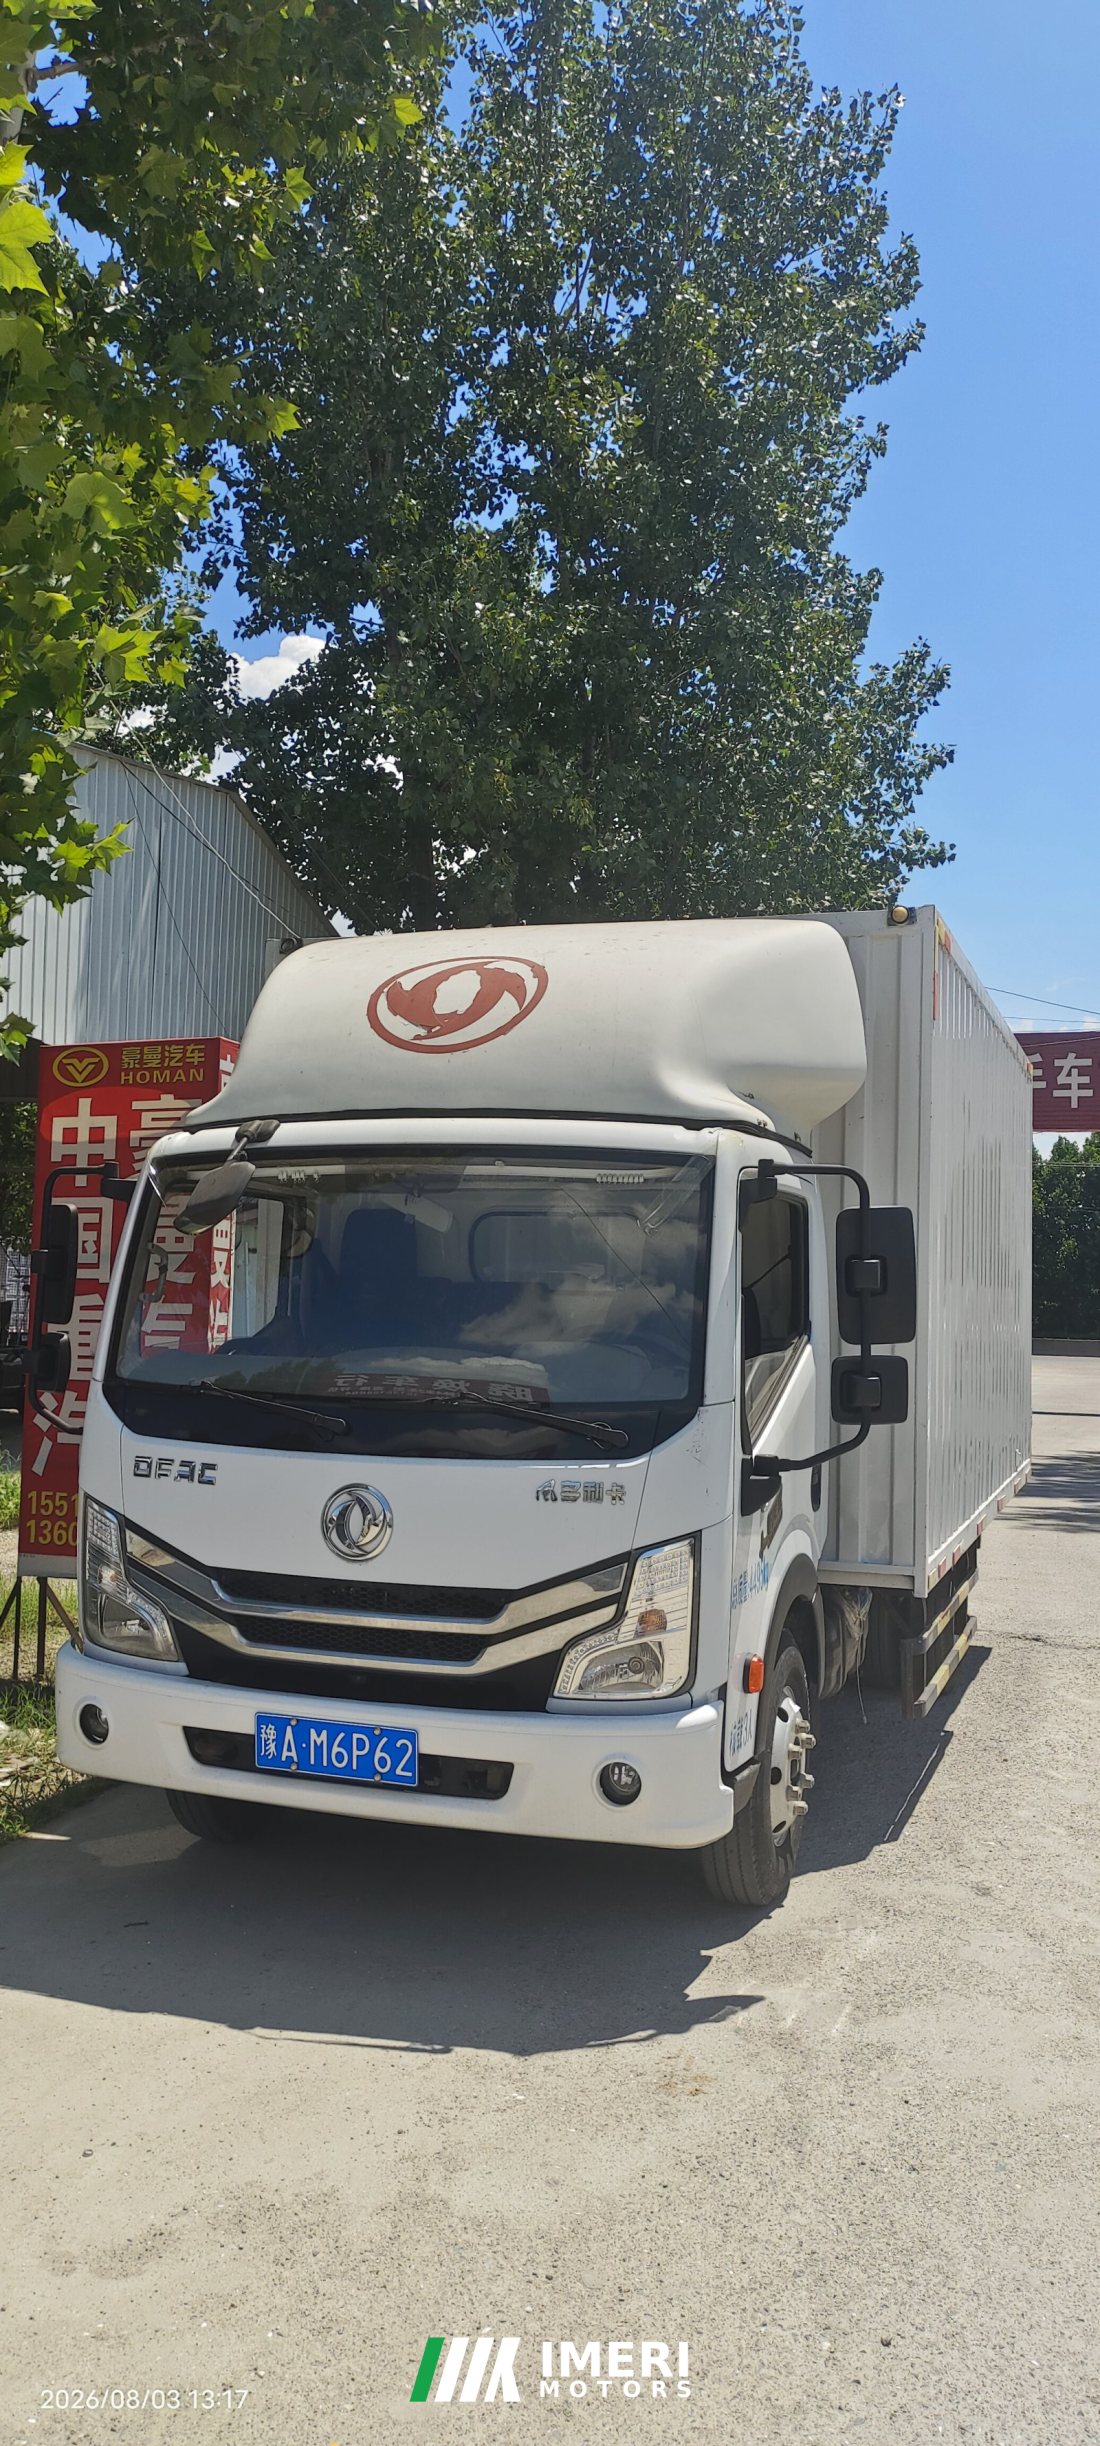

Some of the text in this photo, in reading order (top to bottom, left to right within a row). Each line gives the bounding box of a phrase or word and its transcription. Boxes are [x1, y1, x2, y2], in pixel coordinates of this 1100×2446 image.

[121, 1043, 205, 1069] 豪曼汽车
[120, 1068, 204, 1085] HOMAN
[133, 1456, 218, 1485] DFAC
